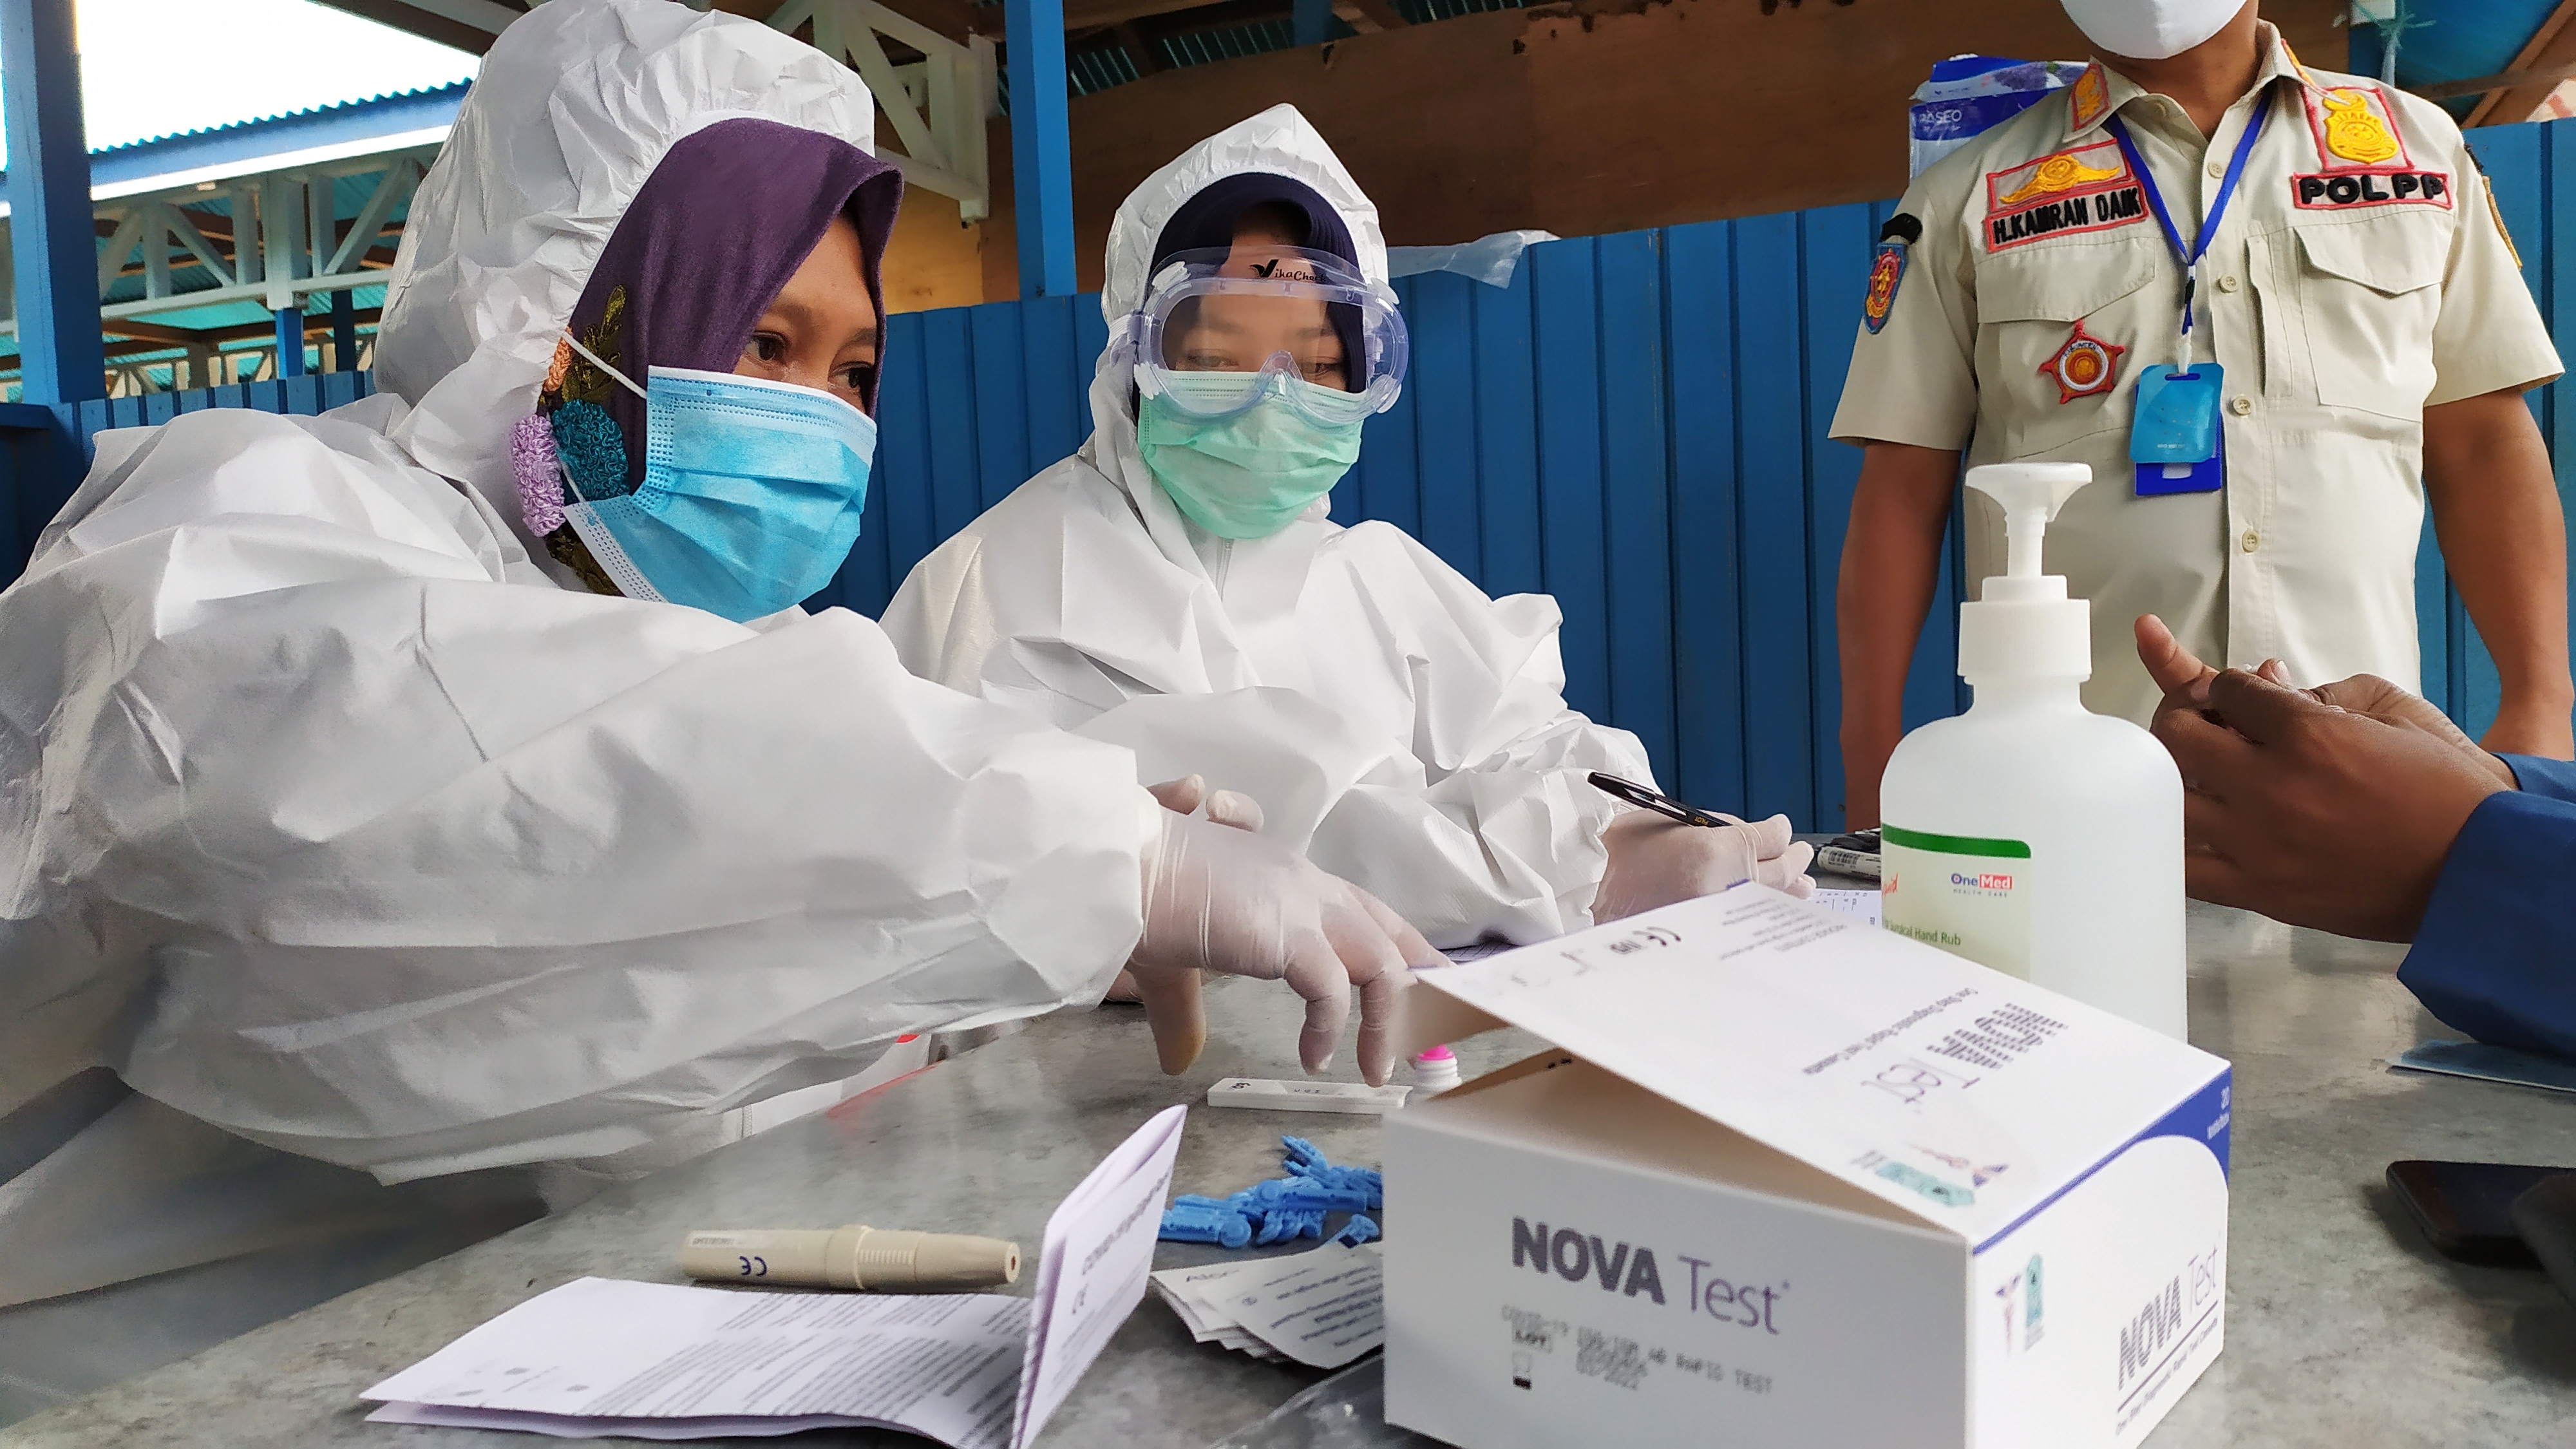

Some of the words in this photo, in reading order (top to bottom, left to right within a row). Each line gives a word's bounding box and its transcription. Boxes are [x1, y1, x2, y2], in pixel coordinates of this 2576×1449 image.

[1951, 873, 2012, 890] OneMed
[1914, 927, 1938, 942] Hand
[1940, 931, 1962, 945] Rub
[1511, 1215, 1667, 1307] NOVA
[1677, 1254, 1781, 1336] Test
[2117, 1274, 2183, 1392] NOVA
[2188, 1244, 2219, 1315] Test
